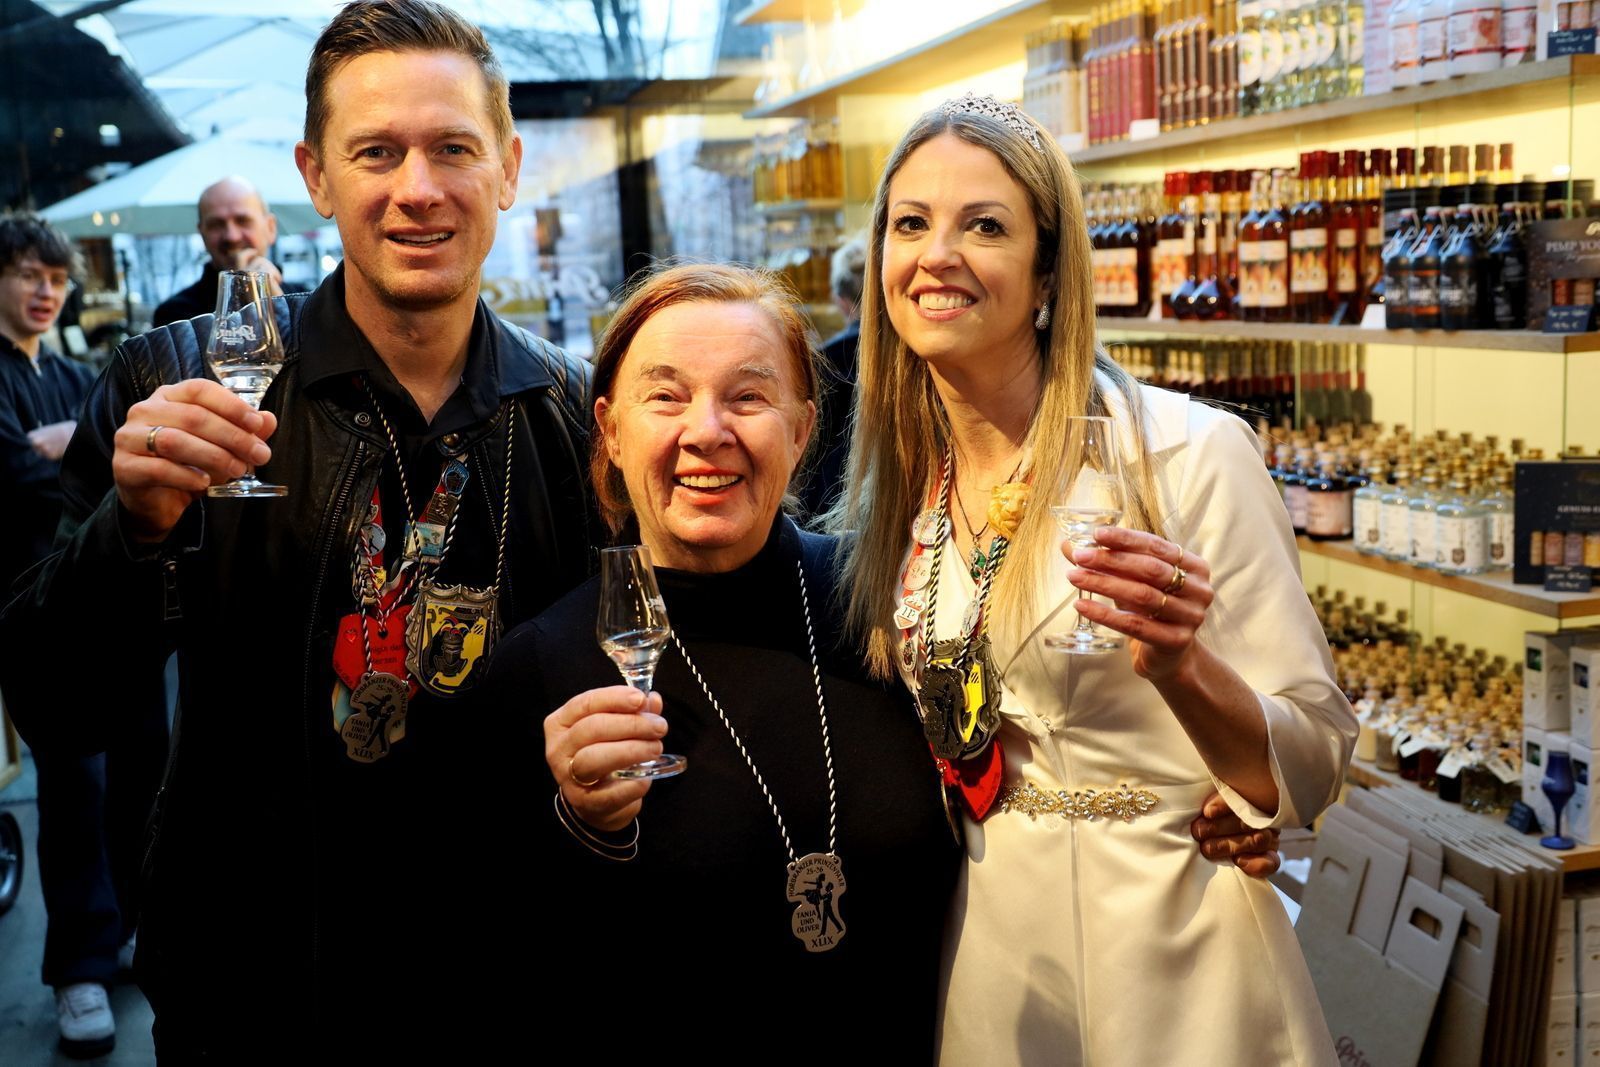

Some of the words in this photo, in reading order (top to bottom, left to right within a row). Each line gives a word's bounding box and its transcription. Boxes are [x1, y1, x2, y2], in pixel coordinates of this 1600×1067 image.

[800, 917, 814, 926] UND
[797, 924, 820, 934] OLIVER
[811, 936, 834, 949] XLIX
